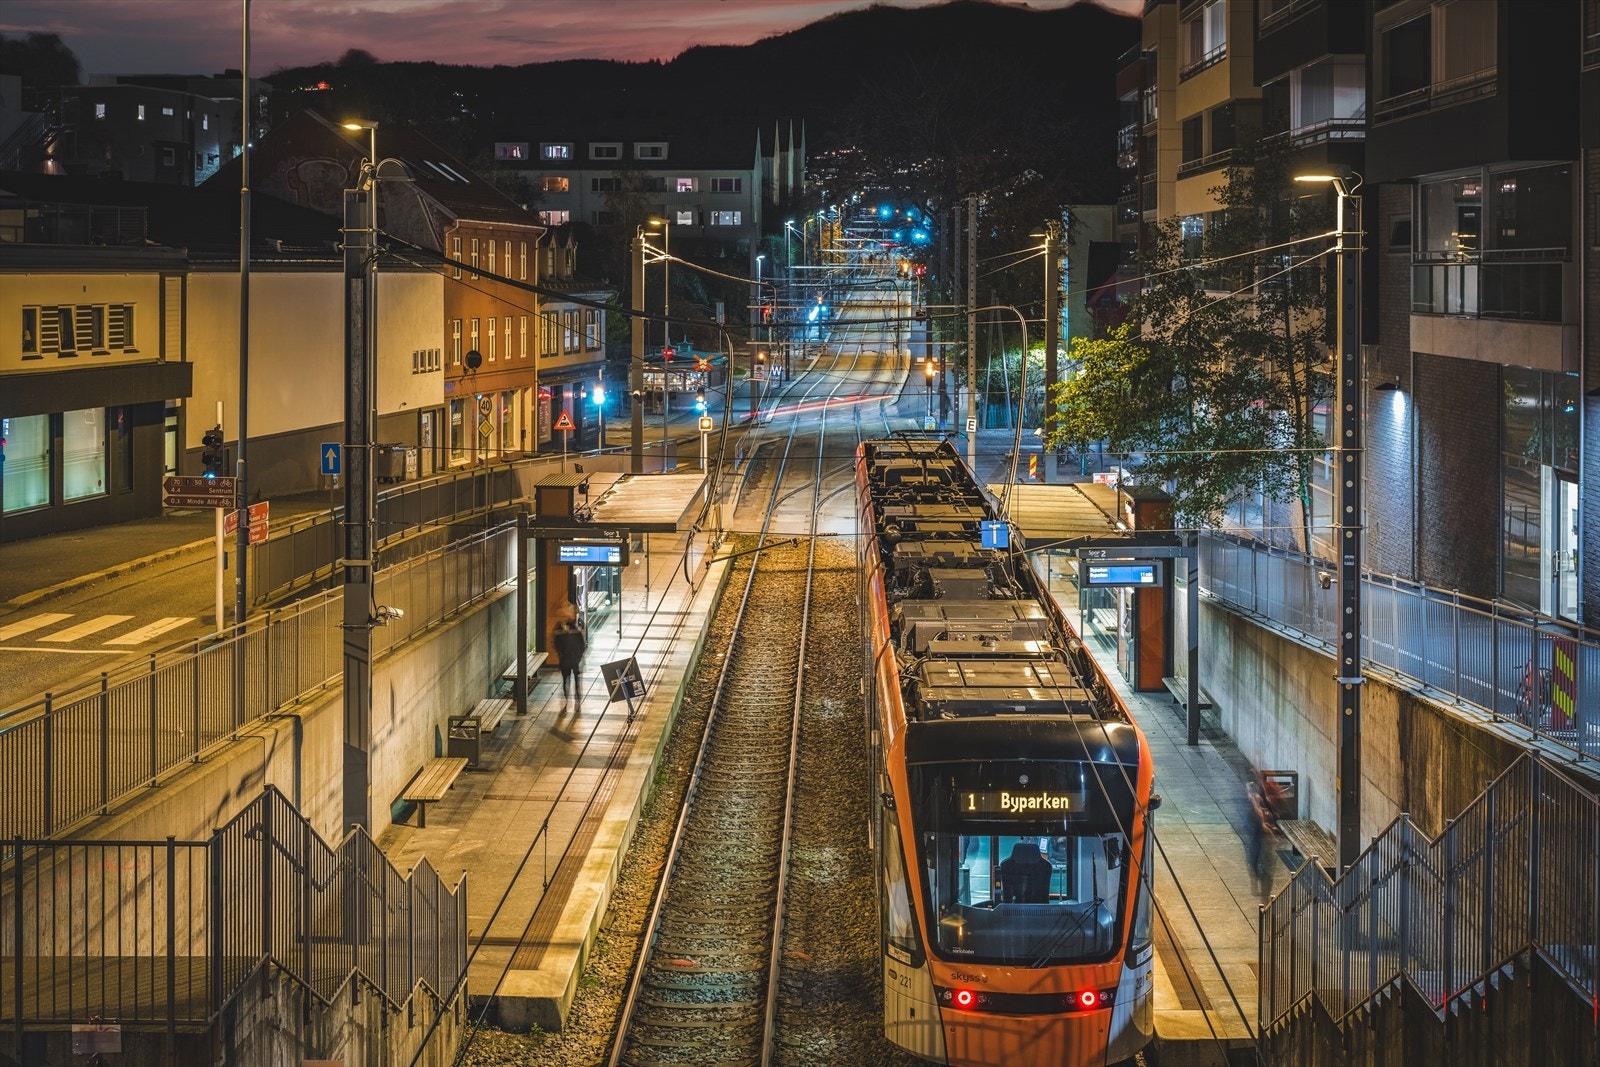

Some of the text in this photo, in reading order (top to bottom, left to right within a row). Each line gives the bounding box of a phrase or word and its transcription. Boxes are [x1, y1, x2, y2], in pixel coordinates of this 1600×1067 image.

[771, 366, 782, 376] W
[481, 400, 490, 411] 40
[968, 420, 975, 430] E
[968, 792, 1069, 813] 1 Byparken
[900, 974, 912, 989] 221
[951, 972, 981, 983] skyss
[1136, 976, 1145, 989] 221
